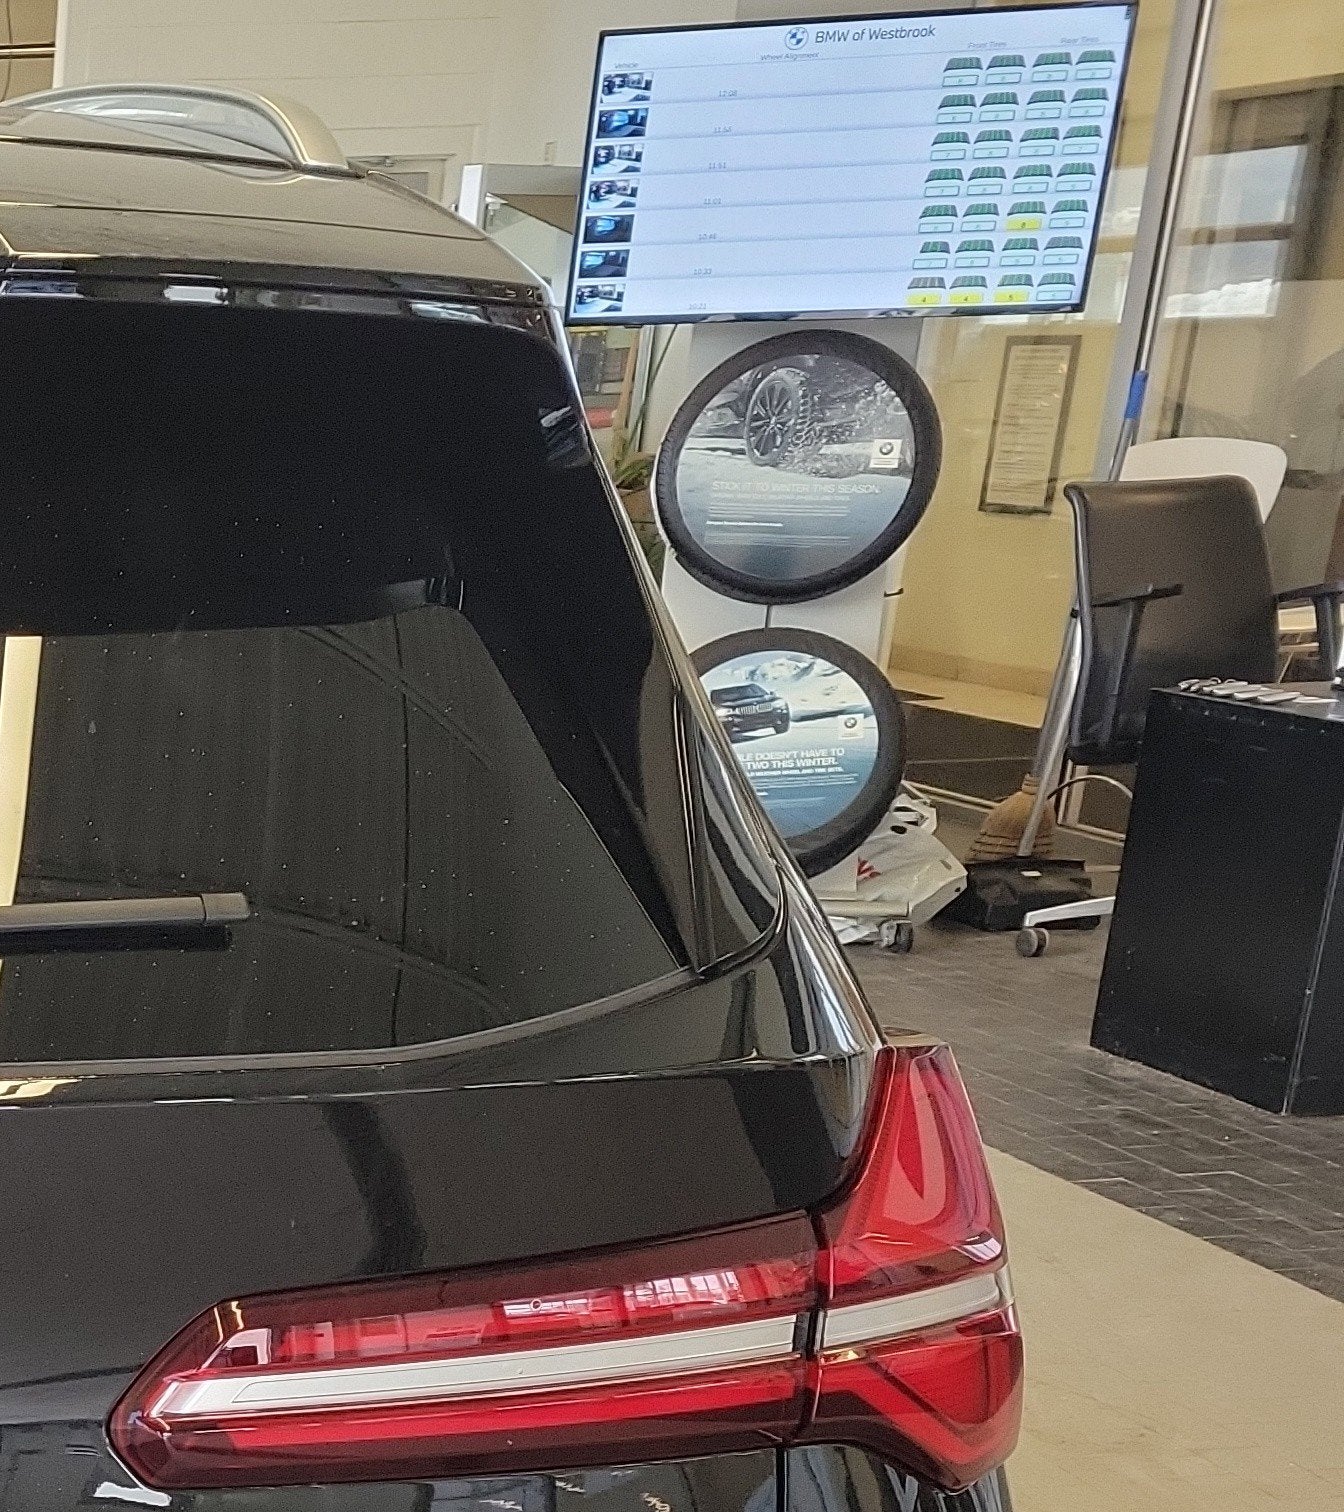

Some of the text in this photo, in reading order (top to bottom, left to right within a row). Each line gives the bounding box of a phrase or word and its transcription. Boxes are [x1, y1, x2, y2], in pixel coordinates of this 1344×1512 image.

[815, 25, 936, 43] BMW of Westbrook
[755, 751, 798, 760] DOESN'T
[801, 749, 827, 758] HAVE
[831, 748, 845, 756] TO
[747, 761, 769, 770] TWO
[771, 759, 795, 768] THIS
